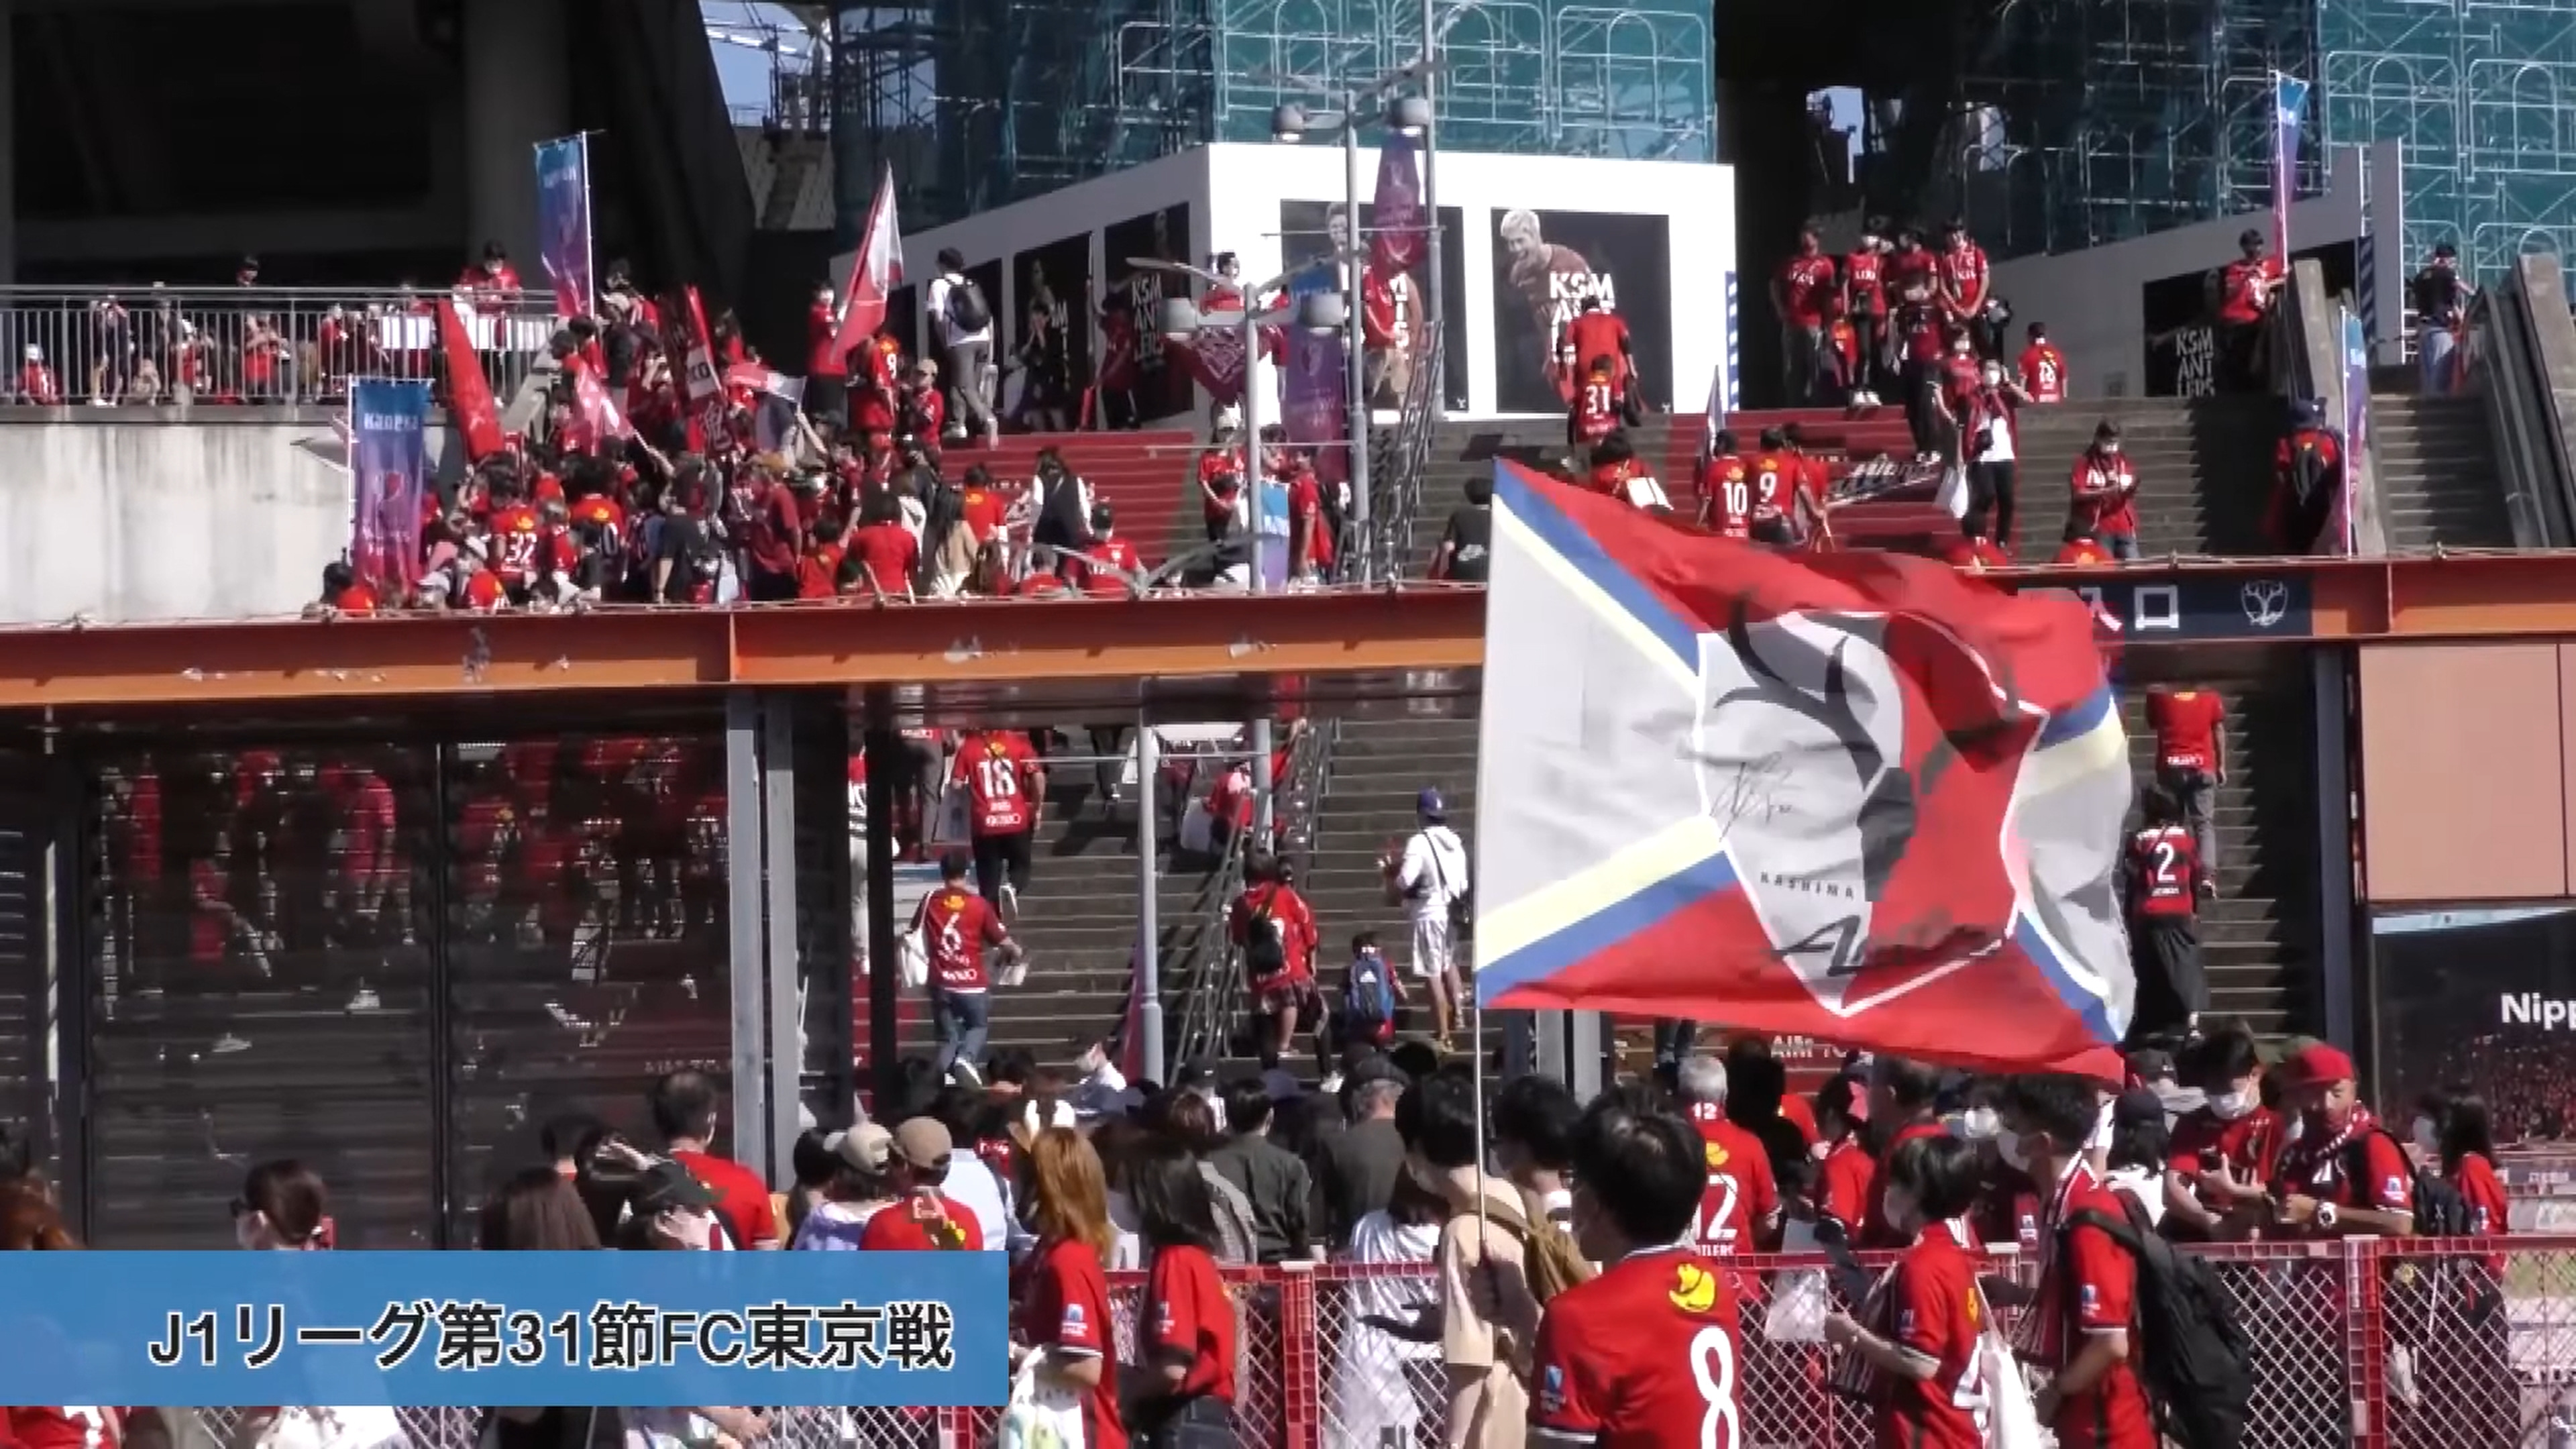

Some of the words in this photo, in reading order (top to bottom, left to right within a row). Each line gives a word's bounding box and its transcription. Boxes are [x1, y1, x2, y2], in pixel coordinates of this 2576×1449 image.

[1549, 270, 1615, 299] KSM
[2176, 326, 2214, 356] KSM
[1585, 384, 1611, 415] 31
[1722, 482, 1748, 516] 10
[1759, 472, 1778, 502] 9
[977, 759, 1016, 798] 18
[2155, 841, 2176, 881] 2
[1760, 871, 1854, 901] KASHIMA
[941, 912, 961, 952] 6
[1693, 1102, 1717, 1121] 12
[1689, 1326, 1741, 1449] 8
